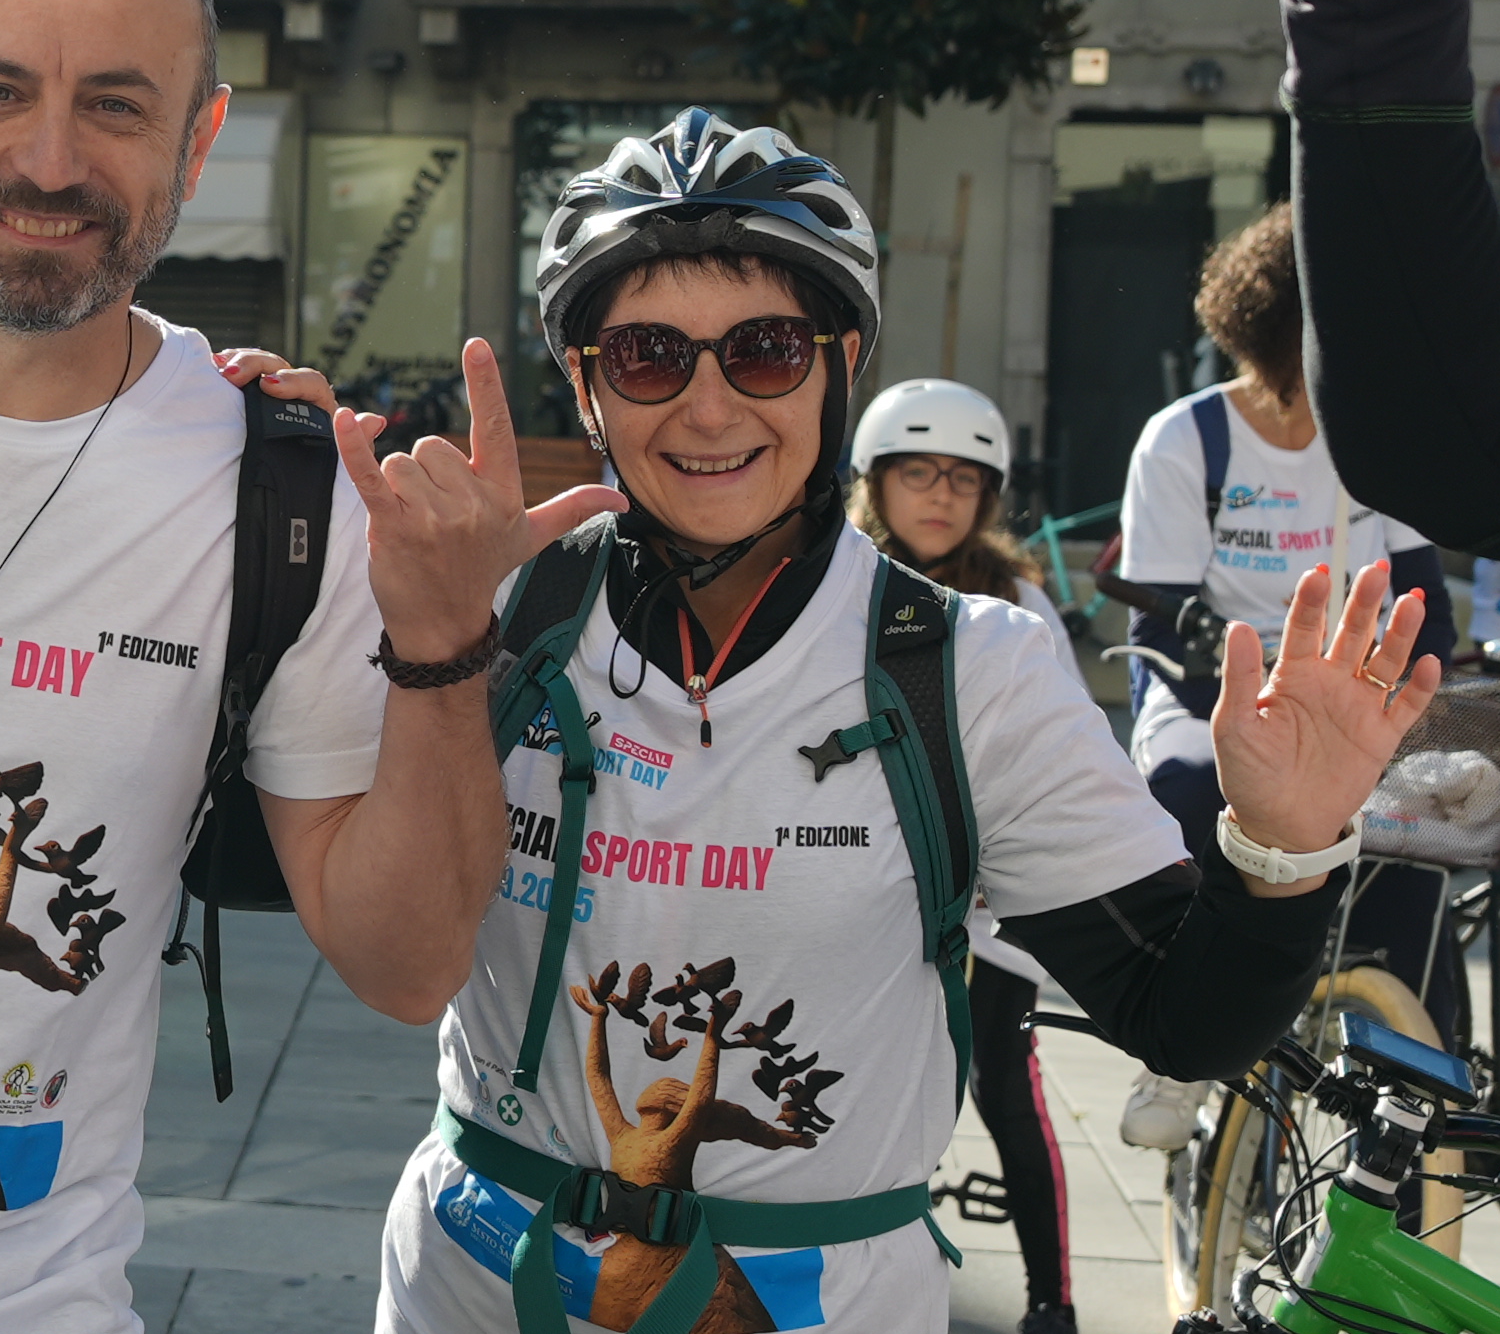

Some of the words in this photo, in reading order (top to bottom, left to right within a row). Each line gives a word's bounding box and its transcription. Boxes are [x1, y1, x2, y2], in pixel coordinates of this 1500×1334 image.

[275, 412, 322, 430] deuter
[885, 624, 927, 636] deuter
[11, 639, 94, 698] DAY
[118, 634, 199, 669] EDIZIONE
[613, 735, 670, 767] SPECIAL
[629, 762, 670, 791] DAY
[581, 830, 693, 886] SPORT
[701, 844, 774, 891] DAY
[795, 825, 870, 849] EDIZIONE
[471, 1222, 498, 1249] SESTO
